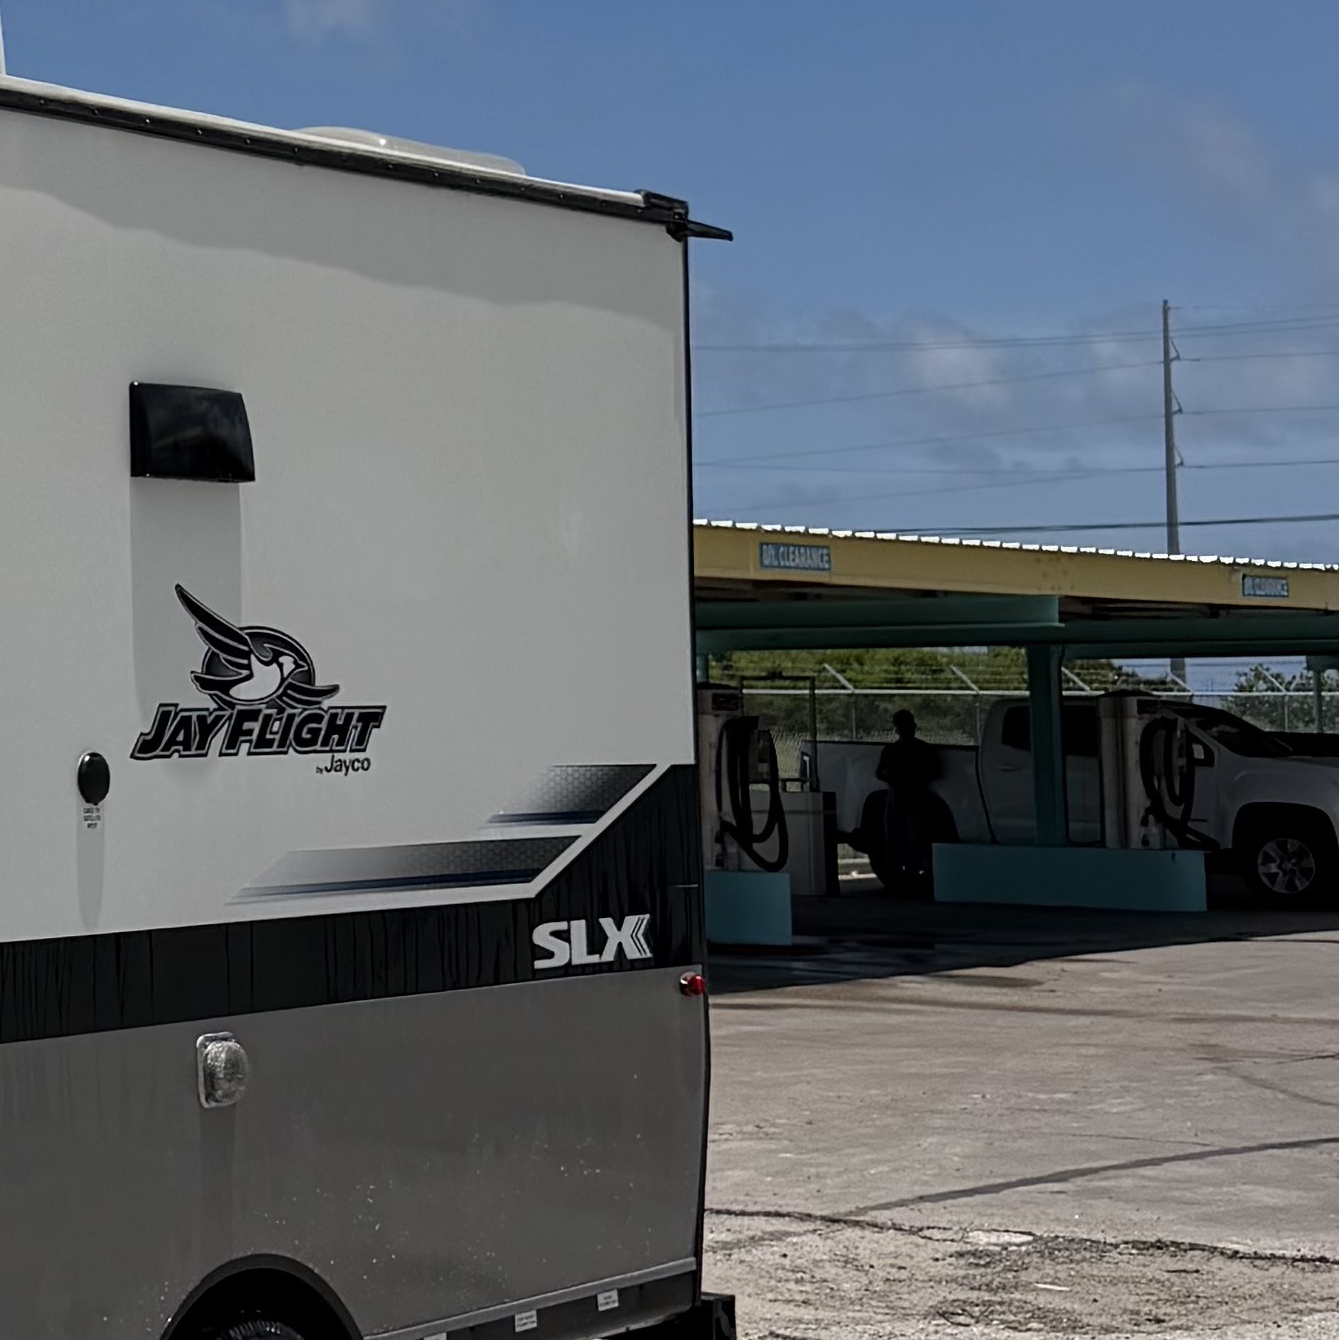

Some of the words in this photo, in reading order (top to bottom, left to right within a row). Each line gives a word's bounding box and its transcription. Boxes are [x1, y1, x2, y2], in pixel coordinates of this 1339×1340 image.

[129, 703, 231, 761] JAY
[219, 704, 387, 757] FLIGHT
[324, 753, 371, 777] Jayco
[532, 913, 653, 970] SLX
